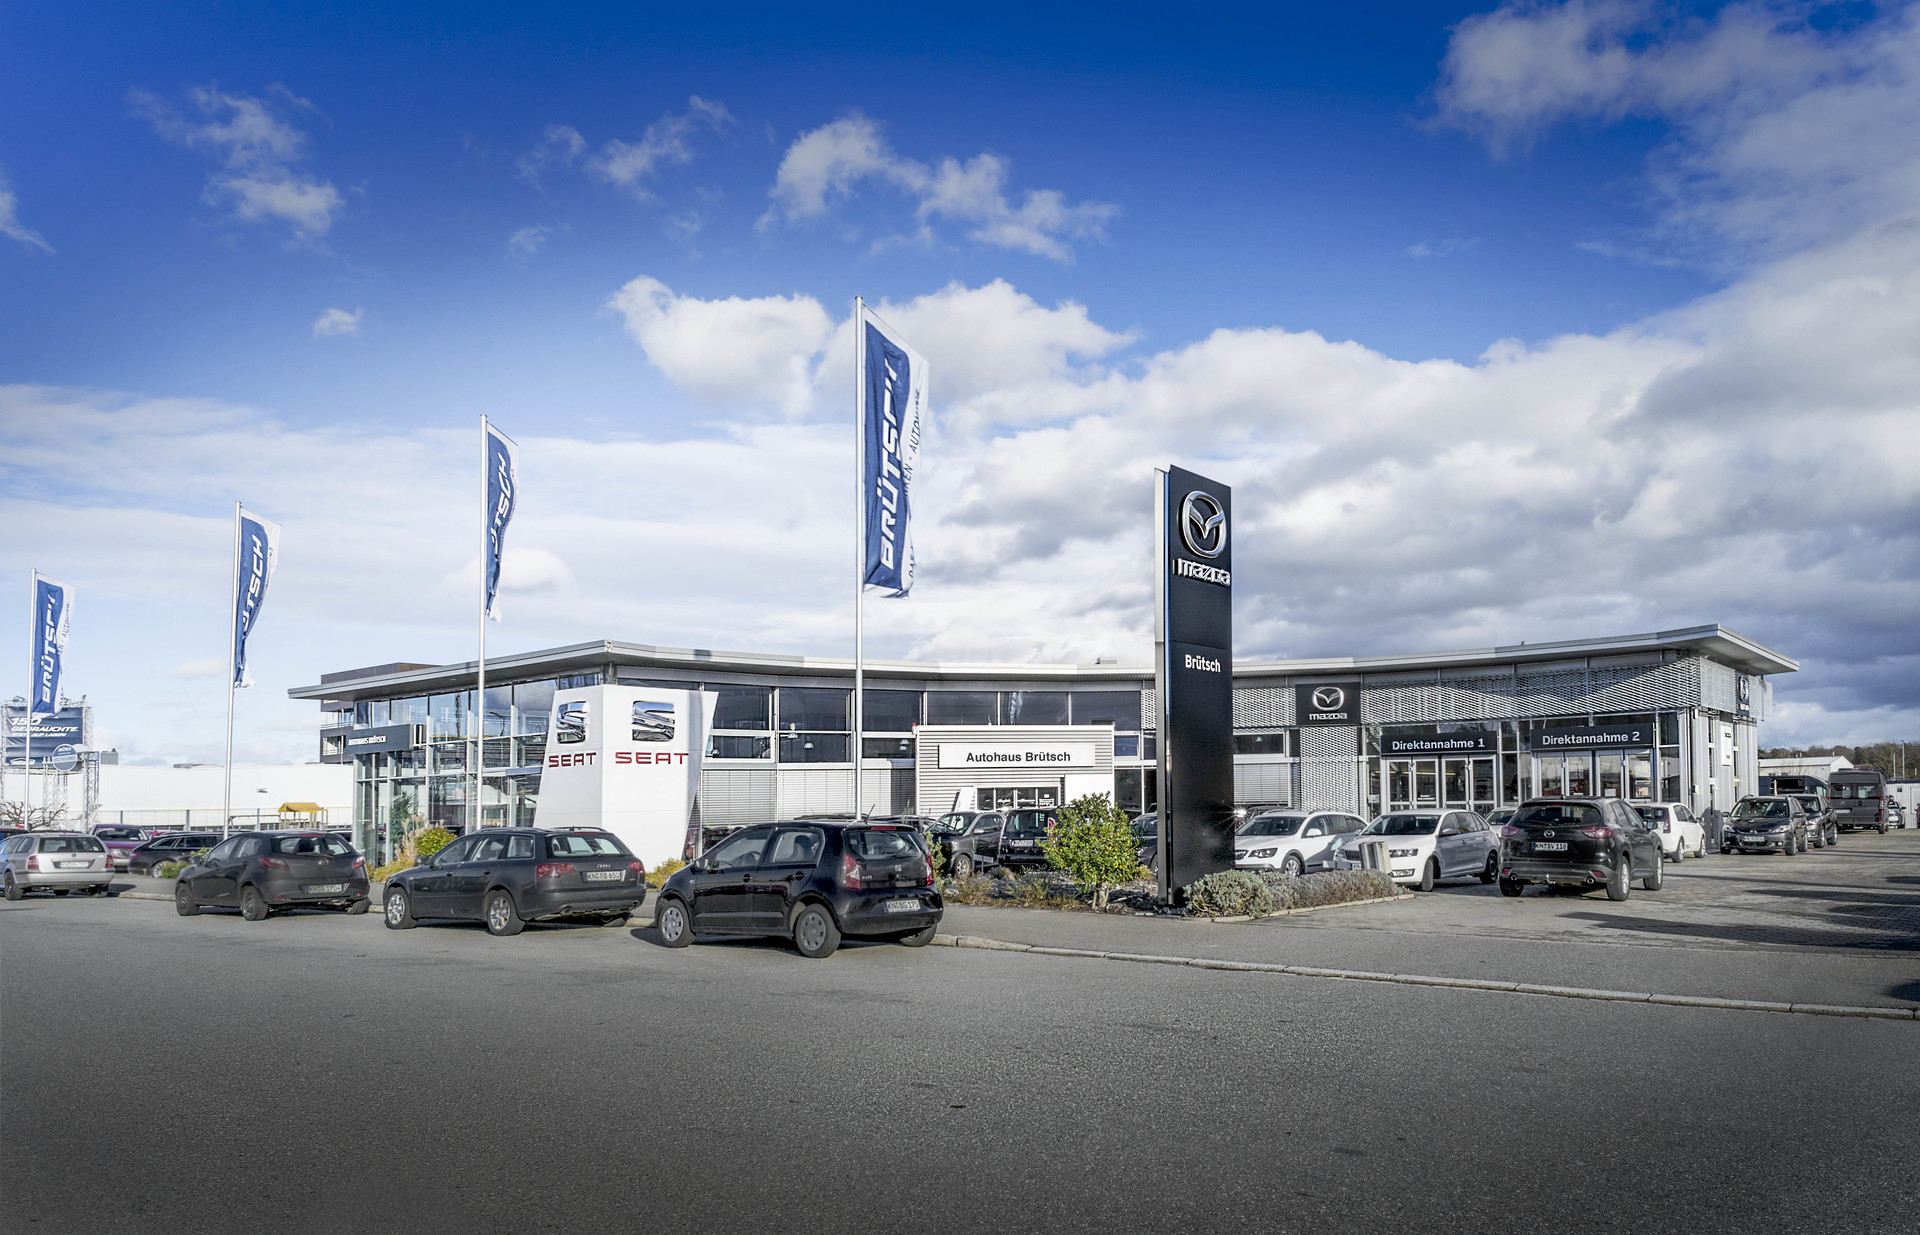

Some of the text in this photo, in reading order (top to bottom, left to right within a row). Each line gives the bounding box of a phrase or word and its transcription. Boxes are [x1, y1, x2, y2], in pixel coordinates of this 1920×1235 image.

[1184, 654, 1221, 673] Brütsch
[1308, 712, 1348, 721] mazda
[1392, 738, 1485, 750] Direktannahme 1
[1542, 731, 1640, 745] Direktannahme 2
[548, 752, 597, 768] SEAT
[615, 751, 689, 765] SEAT
[966, 751, 1071, 763] Autohaus Brütsch
